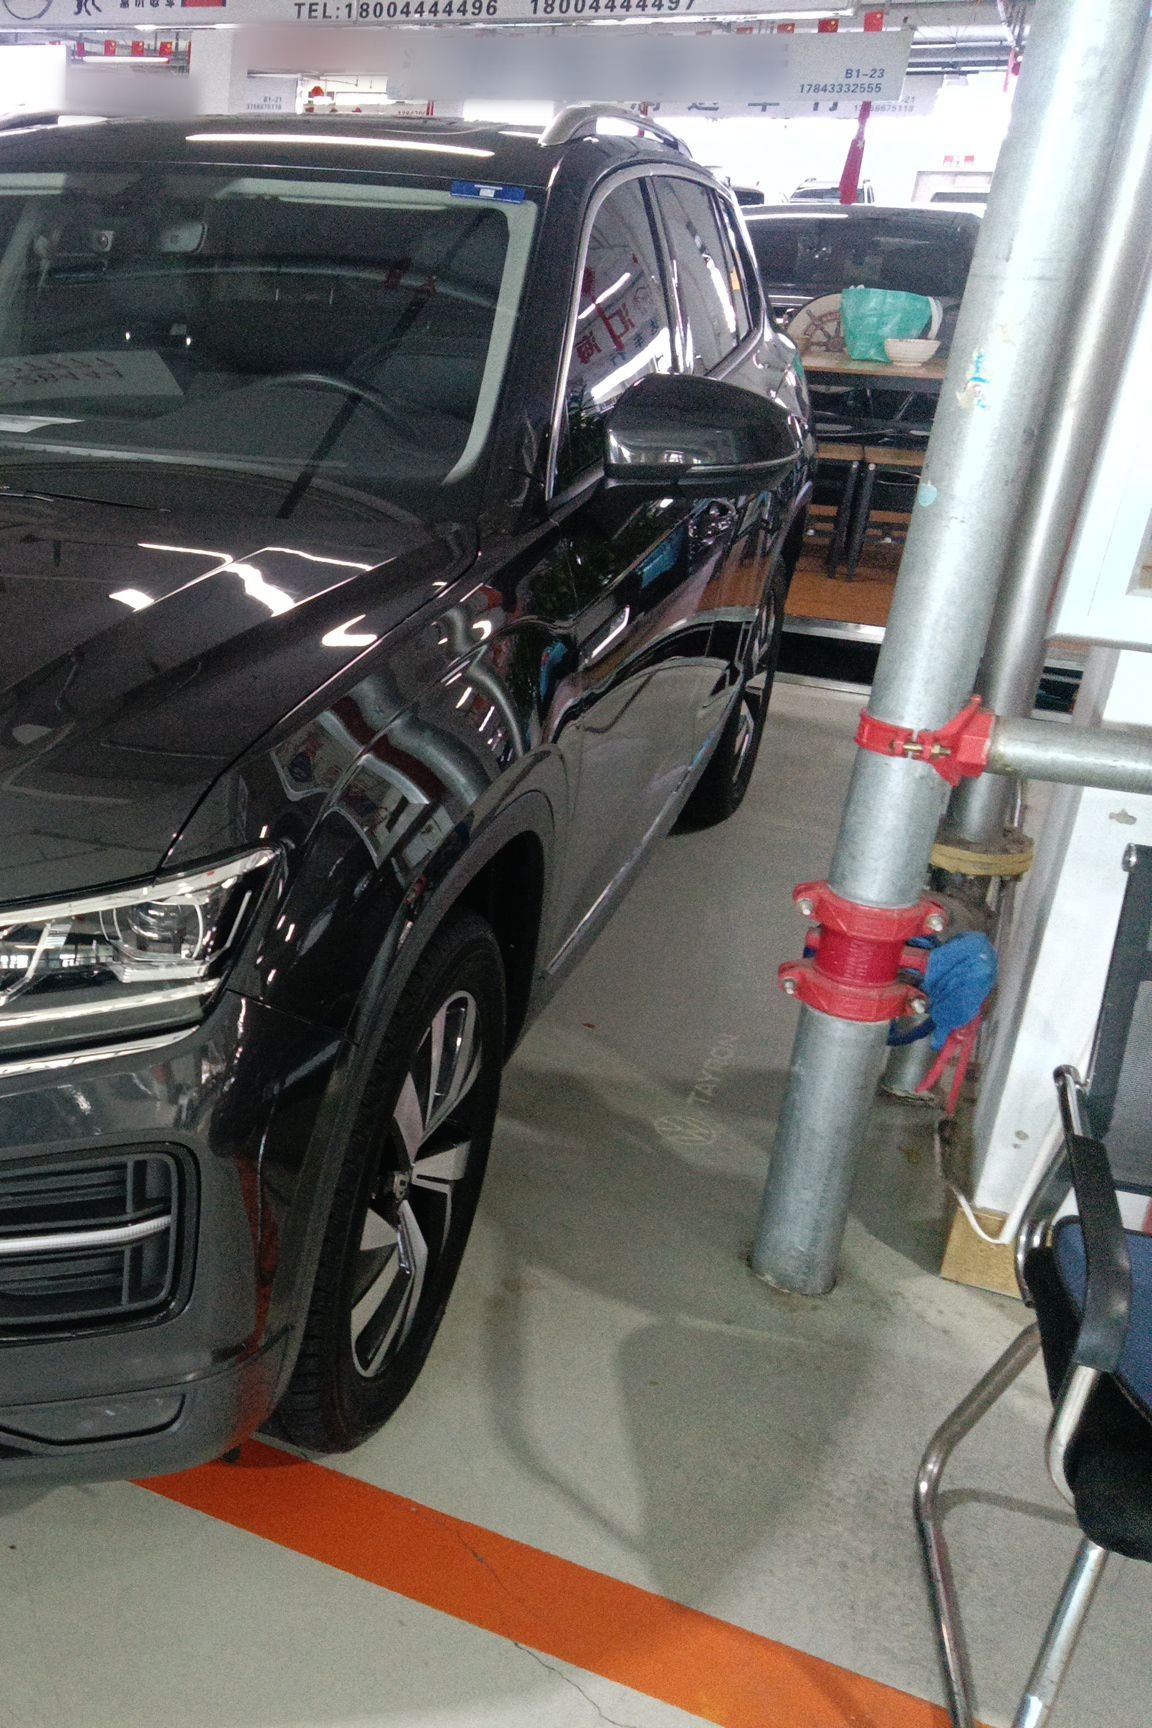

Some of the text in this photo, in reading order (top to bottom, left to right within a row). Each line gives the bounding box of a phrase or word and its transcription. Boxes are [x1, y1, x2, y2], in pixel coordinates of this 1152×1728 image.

[294, 1, 498, 19] TEL:18004444496
[844, 68, 885, 79] B1-23
[799, 83, 882, 94] 17843332555
